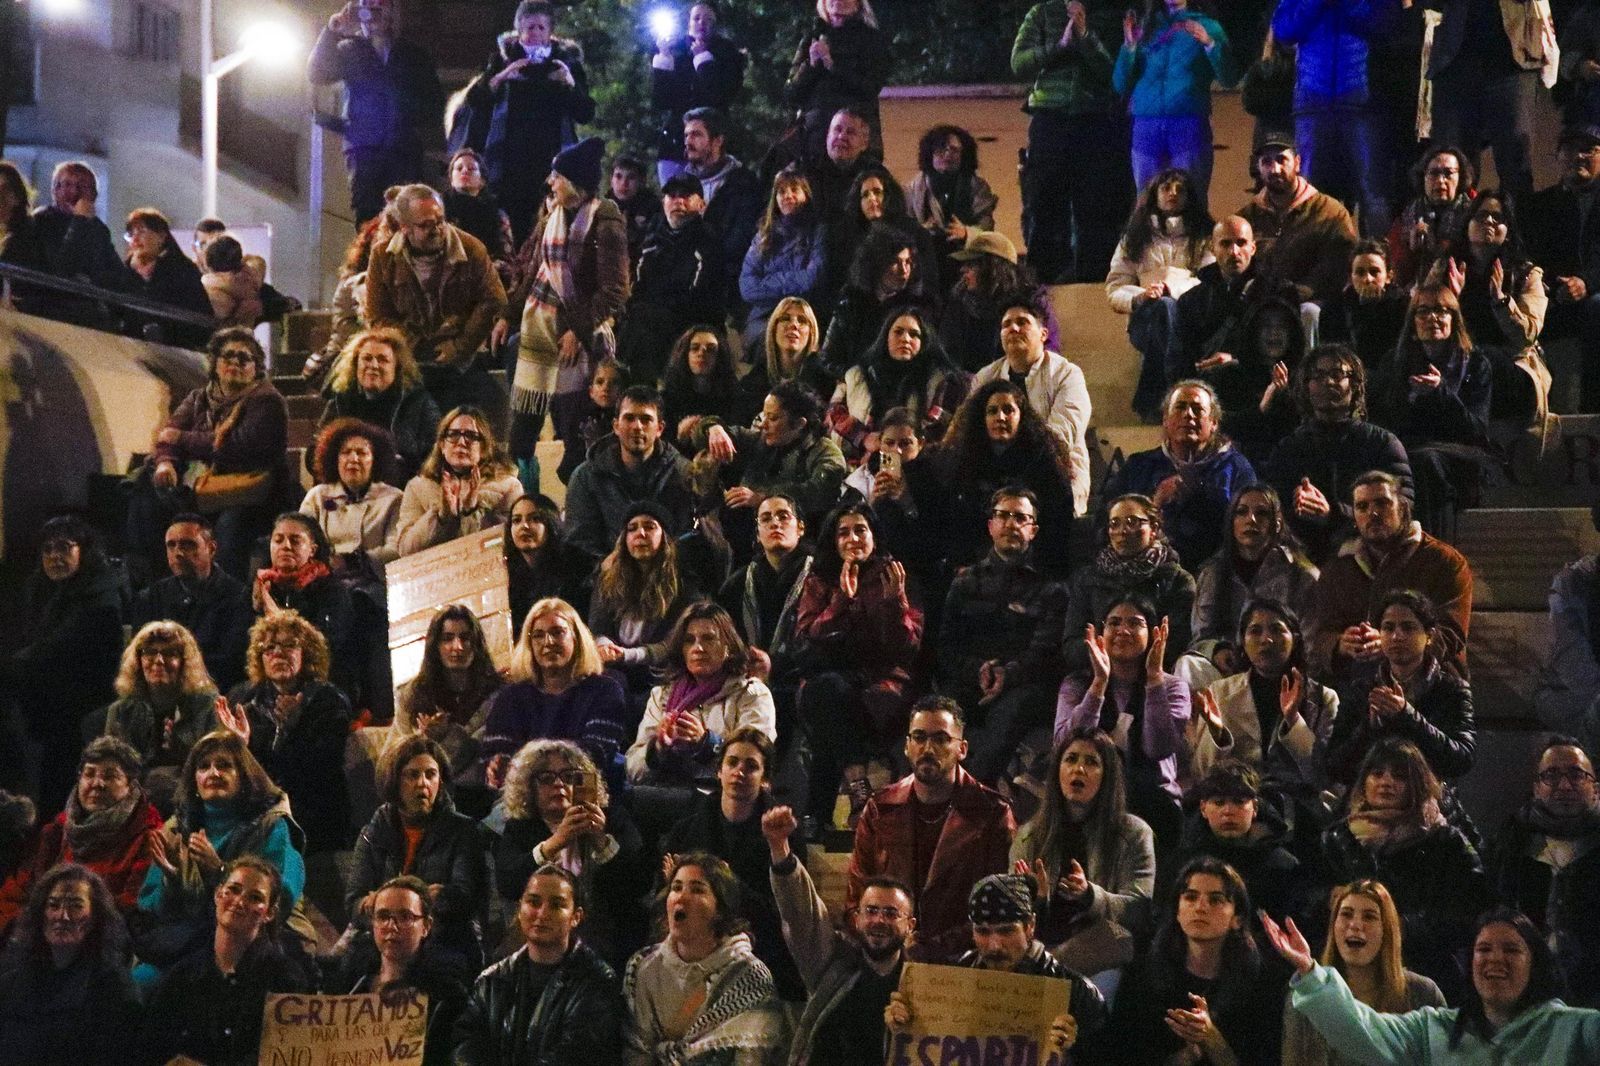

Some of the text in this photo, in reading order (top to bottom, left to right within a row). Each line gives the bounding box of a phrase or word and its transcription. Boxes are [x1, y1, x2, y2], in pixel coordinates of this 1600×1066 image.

[274, 992, 425, 1026] GRITAMOS
[311, 1027, 340, 1043] PARA
[345, 1025, 366, 1040] LAS
[273, 1047, 312, 1066] NO
